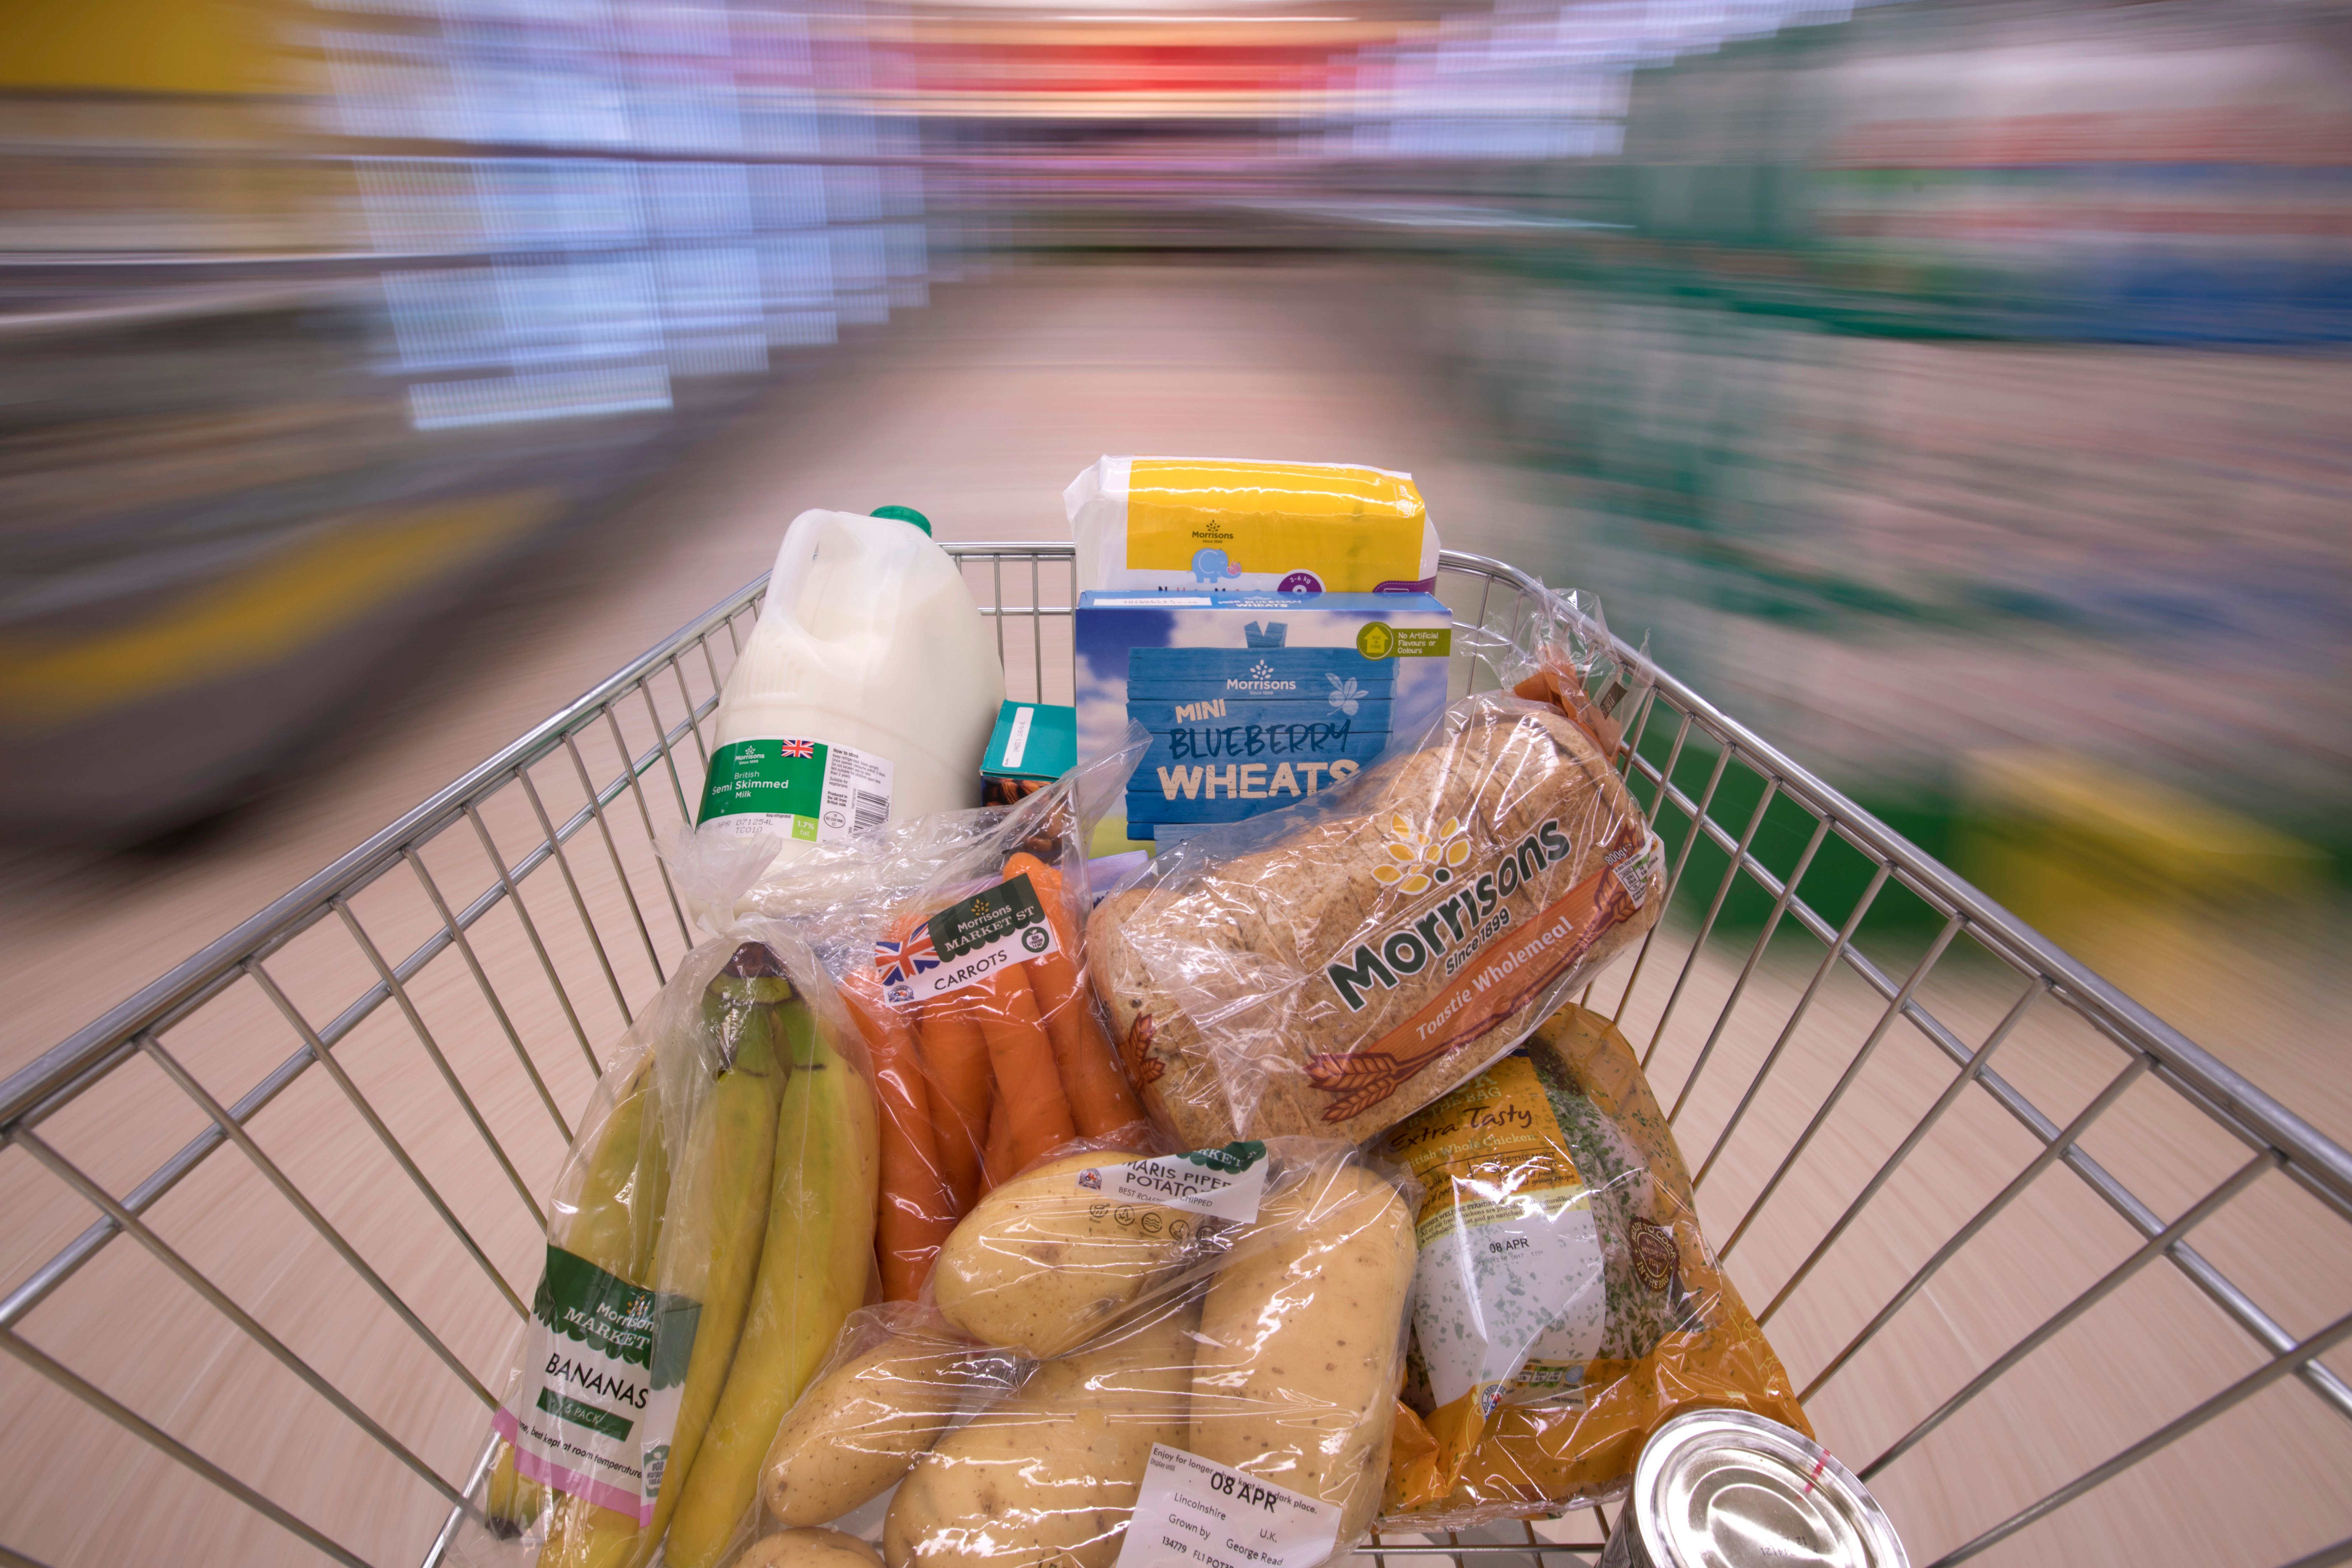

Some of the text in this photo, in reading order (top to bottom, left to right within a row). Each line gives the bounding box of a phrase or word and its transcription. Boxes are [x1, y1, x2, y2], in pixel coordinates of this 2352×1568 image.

[1227, 678, 1296, 691] Morrisons
[1175, 698, 1227, 724] MINI
[1168, 718, 1352, 760] BLUEBERRY
[712, 780, 789, 795] Semi Skimmed
[734, 770, 760, 779] British
[1156, 759, 1362, 801] WHEATS
[797, 820, 815, 830] 1.7%
[1605, 849, 1626, 865] 800g
[957, 905, 1012, 933] Morrisons
[1325, 817, 1571, 1013] Morrisons
[944, 905, 1035, 952] MARKET ST
[1446, 908, 1509, 976] Since 1899
[934, 949, 1008, 991] CARROTS
[1415, 916, 1574, 1041] Toastie Wholemeal
[1431, 1095, 1461, 1117] THE
[1466, 1087, 1501, 1102] BAG
[1391, 1104, 1532, 1151] Extra Tasty
[1439, 1133, 1536, 1156] Whole Chicken
[1429, 1175, 1443, 1191] with
[1532, 1178, 1552, 1186] gravy
[1539, 1168, 1556, 1176] pack
[1119, 1186, 1136, 1197] BEST
[1420, 1218, 1438, 1231] HIGHER
[1489, 1238, 1530, 1253] 08 APR
[1632, 1222, 1676, 1259] READY TO COOK
[1641, 1246, 1667, 1261] MESS OR
[1646, 1238, 1657, 1247] NO
[1637, 1261, 1669, 1289] IN THE BAG
[563, 1307, 651, 1350] MARKET
[545, 1353, 648, 1409] BANANAS
[574, 1408, 601, 1424] PACK
[531, 1426, 642, 1478] best kept at room temperature
[1150, 1458, 1175, 1471] Display until
[1153, 1447, 1174, 1462] Enjoy
[1175, 1456, 1187, 1465] for
[1189, 1458, 1213, 1474] longer
[1237, 1477, 1256, 1490] kept
[1274, 1493, 1292, 1504] dark
[1294, 1499, 1317, 1514] place.
[1210, 1471, 1278, 1513] 08 APR
[1174, 1492, 1226, 1521] Lincolnshire
[1169, 1514, 1211, 1539] Grown by
[1260, 1528, 1277, 1543] U.K.
[1162, 1536, 1187, 1553] 134779
[1226, 1539, 1283, 1566] George Read
